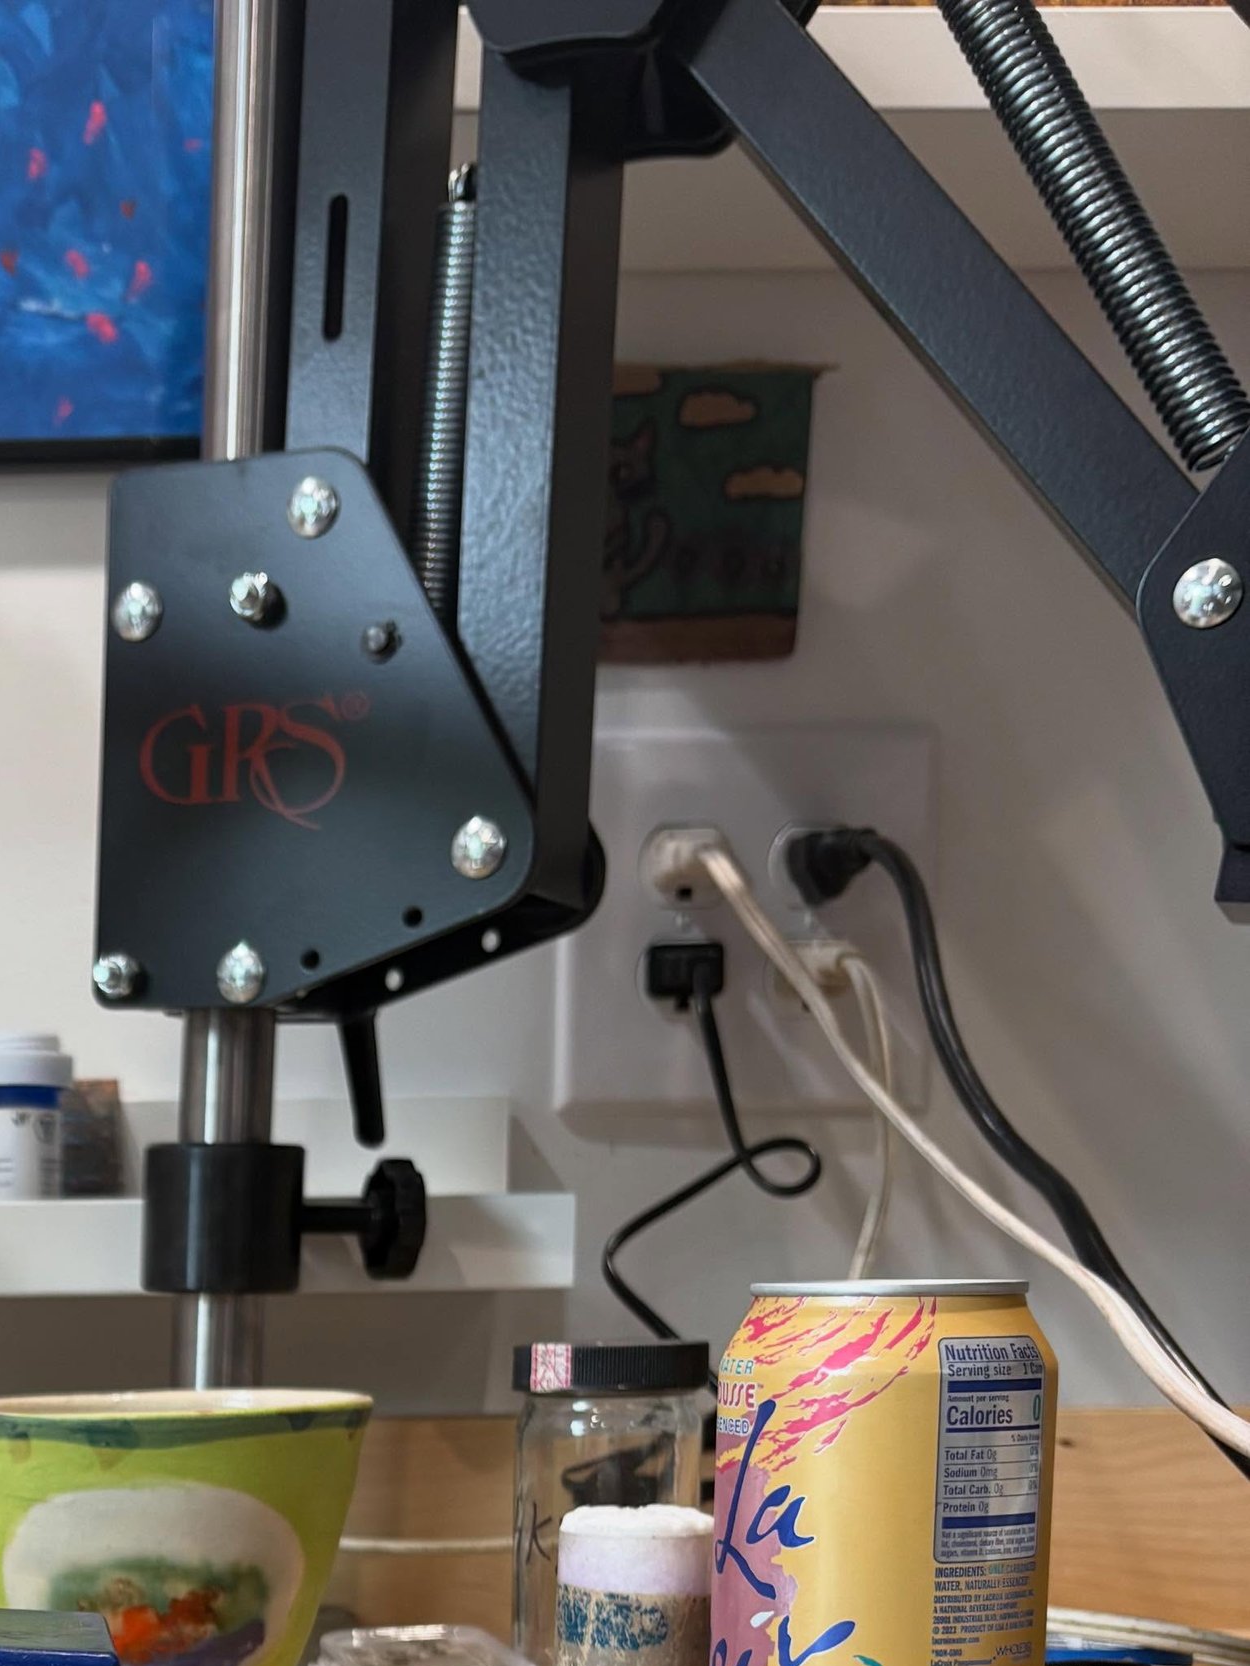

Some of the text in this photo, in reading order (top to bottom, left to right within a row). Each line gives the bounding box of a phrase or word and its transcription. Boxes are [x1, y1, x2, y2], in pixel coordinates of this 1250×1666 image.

[945, 1343, 1039, 1361] Nutrition Facts
[720, 1359, 754, 1375] ATER
[948, 1364, 990, 1379] Serving
[994, 1363, 1012, 1376] size
[1023, 1363, 1028, 1375] 1
[947, 1394, 1041, 1425] Calories 0
[945, 1450, 967, 1460] Total
[970, 1449, 984, 1460] Fat
[944, 1467, 977, 1478] Sodium
[943, 1485, 966, 1495] Total
[968, 1484, 991, 1495] Carb.
[715, 1399, 814, 1600] La
[943, 1502, 975, 1513] Protein
[935, 1566, 986, 1578] INGREDIENTS:
[934, 1580, 962, 1592] WATER,
